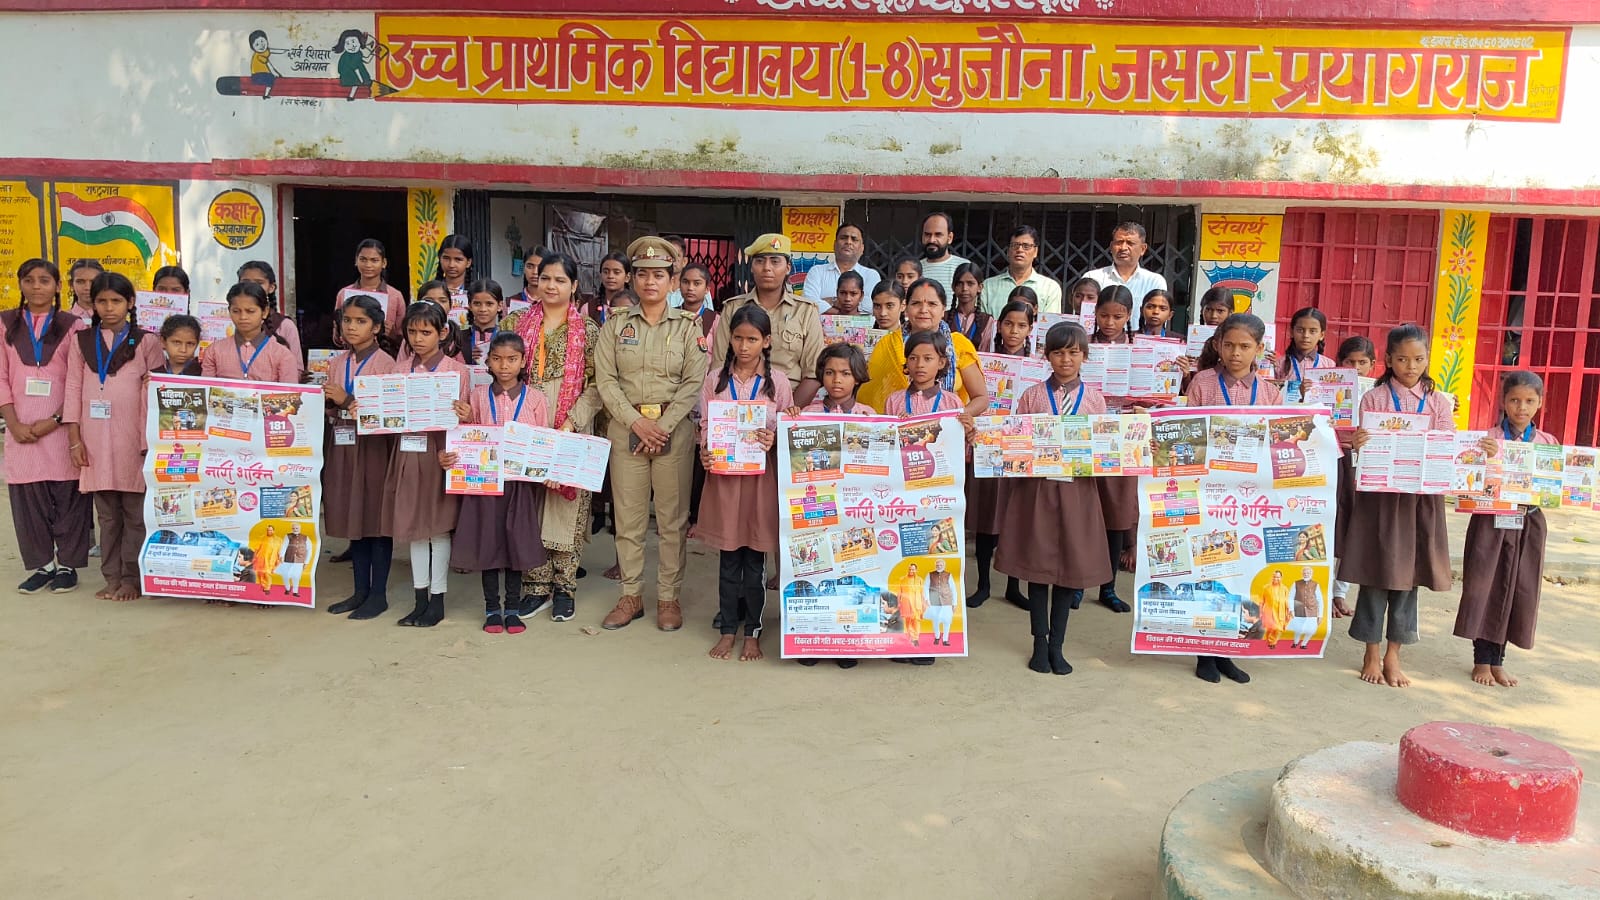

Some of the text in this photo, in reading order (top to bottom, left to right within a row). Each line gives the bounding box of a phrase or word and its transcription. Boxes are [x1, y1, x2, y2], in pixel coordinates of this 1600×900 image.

[304, 46, 332, 60] शिक्षा
[384, 34, 470, 90] उच्च
[472, 22, 652, 96] प्राथमिक
[291, 60, 331, 72] अभियान
[1207, 215, 1270, 236] सेवार्थ
[791, 226, 830, 249] आइये
[1212, 236, 1268, 260] जाइये
[160, 389, 184, 398] महिला
[161, 398, 182, 408] सुरक्षा
[269, 420, 286, 430] 181
[1155, 423, 1180, 432] महिला
[792, 429, 817, 438] महिला
[1155, 432, 1179, 442] सुरक्षा
[792, 438, 815, 448] सुरक्षा
[906, 450, 925, 461] 181
[1276, 448, 1295, 459] 181
[205, 460, 235, 485] नारी
[236, 462, 283, 488] शक्ति
[844, 498, 875, 524] नारी
[877, 497, 925, 524] शक्ति
[1206, 495, 1239, 526] नारी
[1241, 495, 1290, 527] शक्ति
